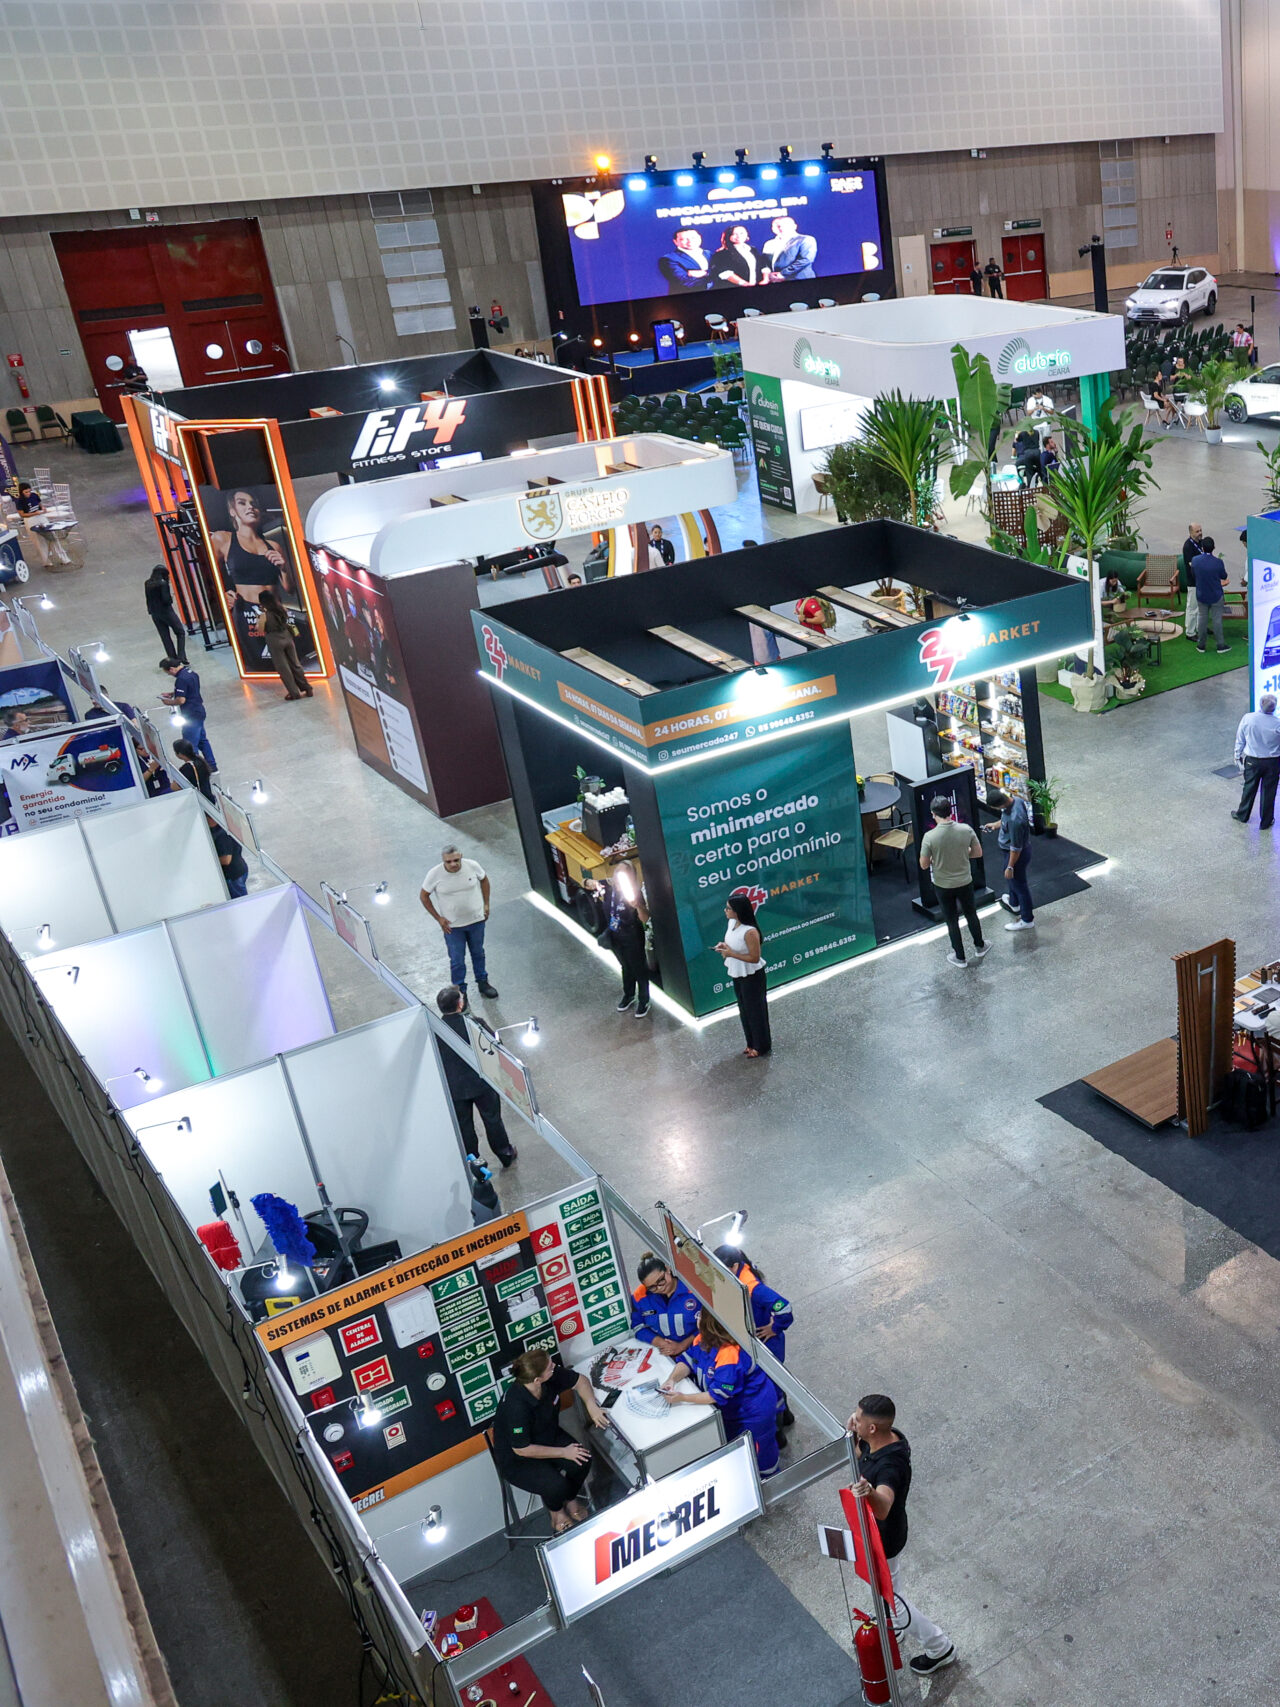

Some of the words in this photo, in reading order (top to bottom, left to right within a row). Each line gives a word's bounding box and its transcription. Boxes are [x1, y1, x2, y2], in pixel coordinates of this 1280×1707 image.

[352, 453, 406, 469] FITNESS
[411, 444, 453, 458] STORE
[565, 487, 594, 497] GRUPO
[508, 655, 541, 682] MARKET
[654, 726, 670, 737] 24
[671, 714, 714, 733] HORAS,
[714, 709, 728, 721] 07
[20, 789, 53, 802] Energia
[686, 793, 752, 822] Somos
[755, 788, 768, 801] o
[38, 807, 53, 815] seu
[690, 794, 819, 845] minimercado
[694, 843, 743, 867] certo
[747, 828, 790, 854] para
[794, 821, 806, 834] o
[698, 868, 731, 888] seu
[736, 832, 842, 876] condomínio
[770, 872, 821, 897] MARKET
[563, 1193, 595, 1213] SAÍDA
[582, 1212, 600, 1223] SAÍDA
[572, 1237, 590, 1248] SAÍDA
[577, 1250, 609, 1270] SAÍDA
[267, 1309, 325, 1341] SISTEMAS
[326, 1299, 342, 1314] DE
[343, 1281, 388, 1308] ALARME
[388, 1277, 395, 1288] E
[397, 1253, 450, 1287] DETECÇÃO
[452, 1246, 465, 1260] DE
[466, 1222, 521, 1256] INCÊNDIOS
[598, 1266, 615, 1277] SAÍDA
[346, 1322, 371, 1336] CENTRAL
[350, 1334, 374, 1349] ALARME
[474, 1395, 493, 1412] SS
